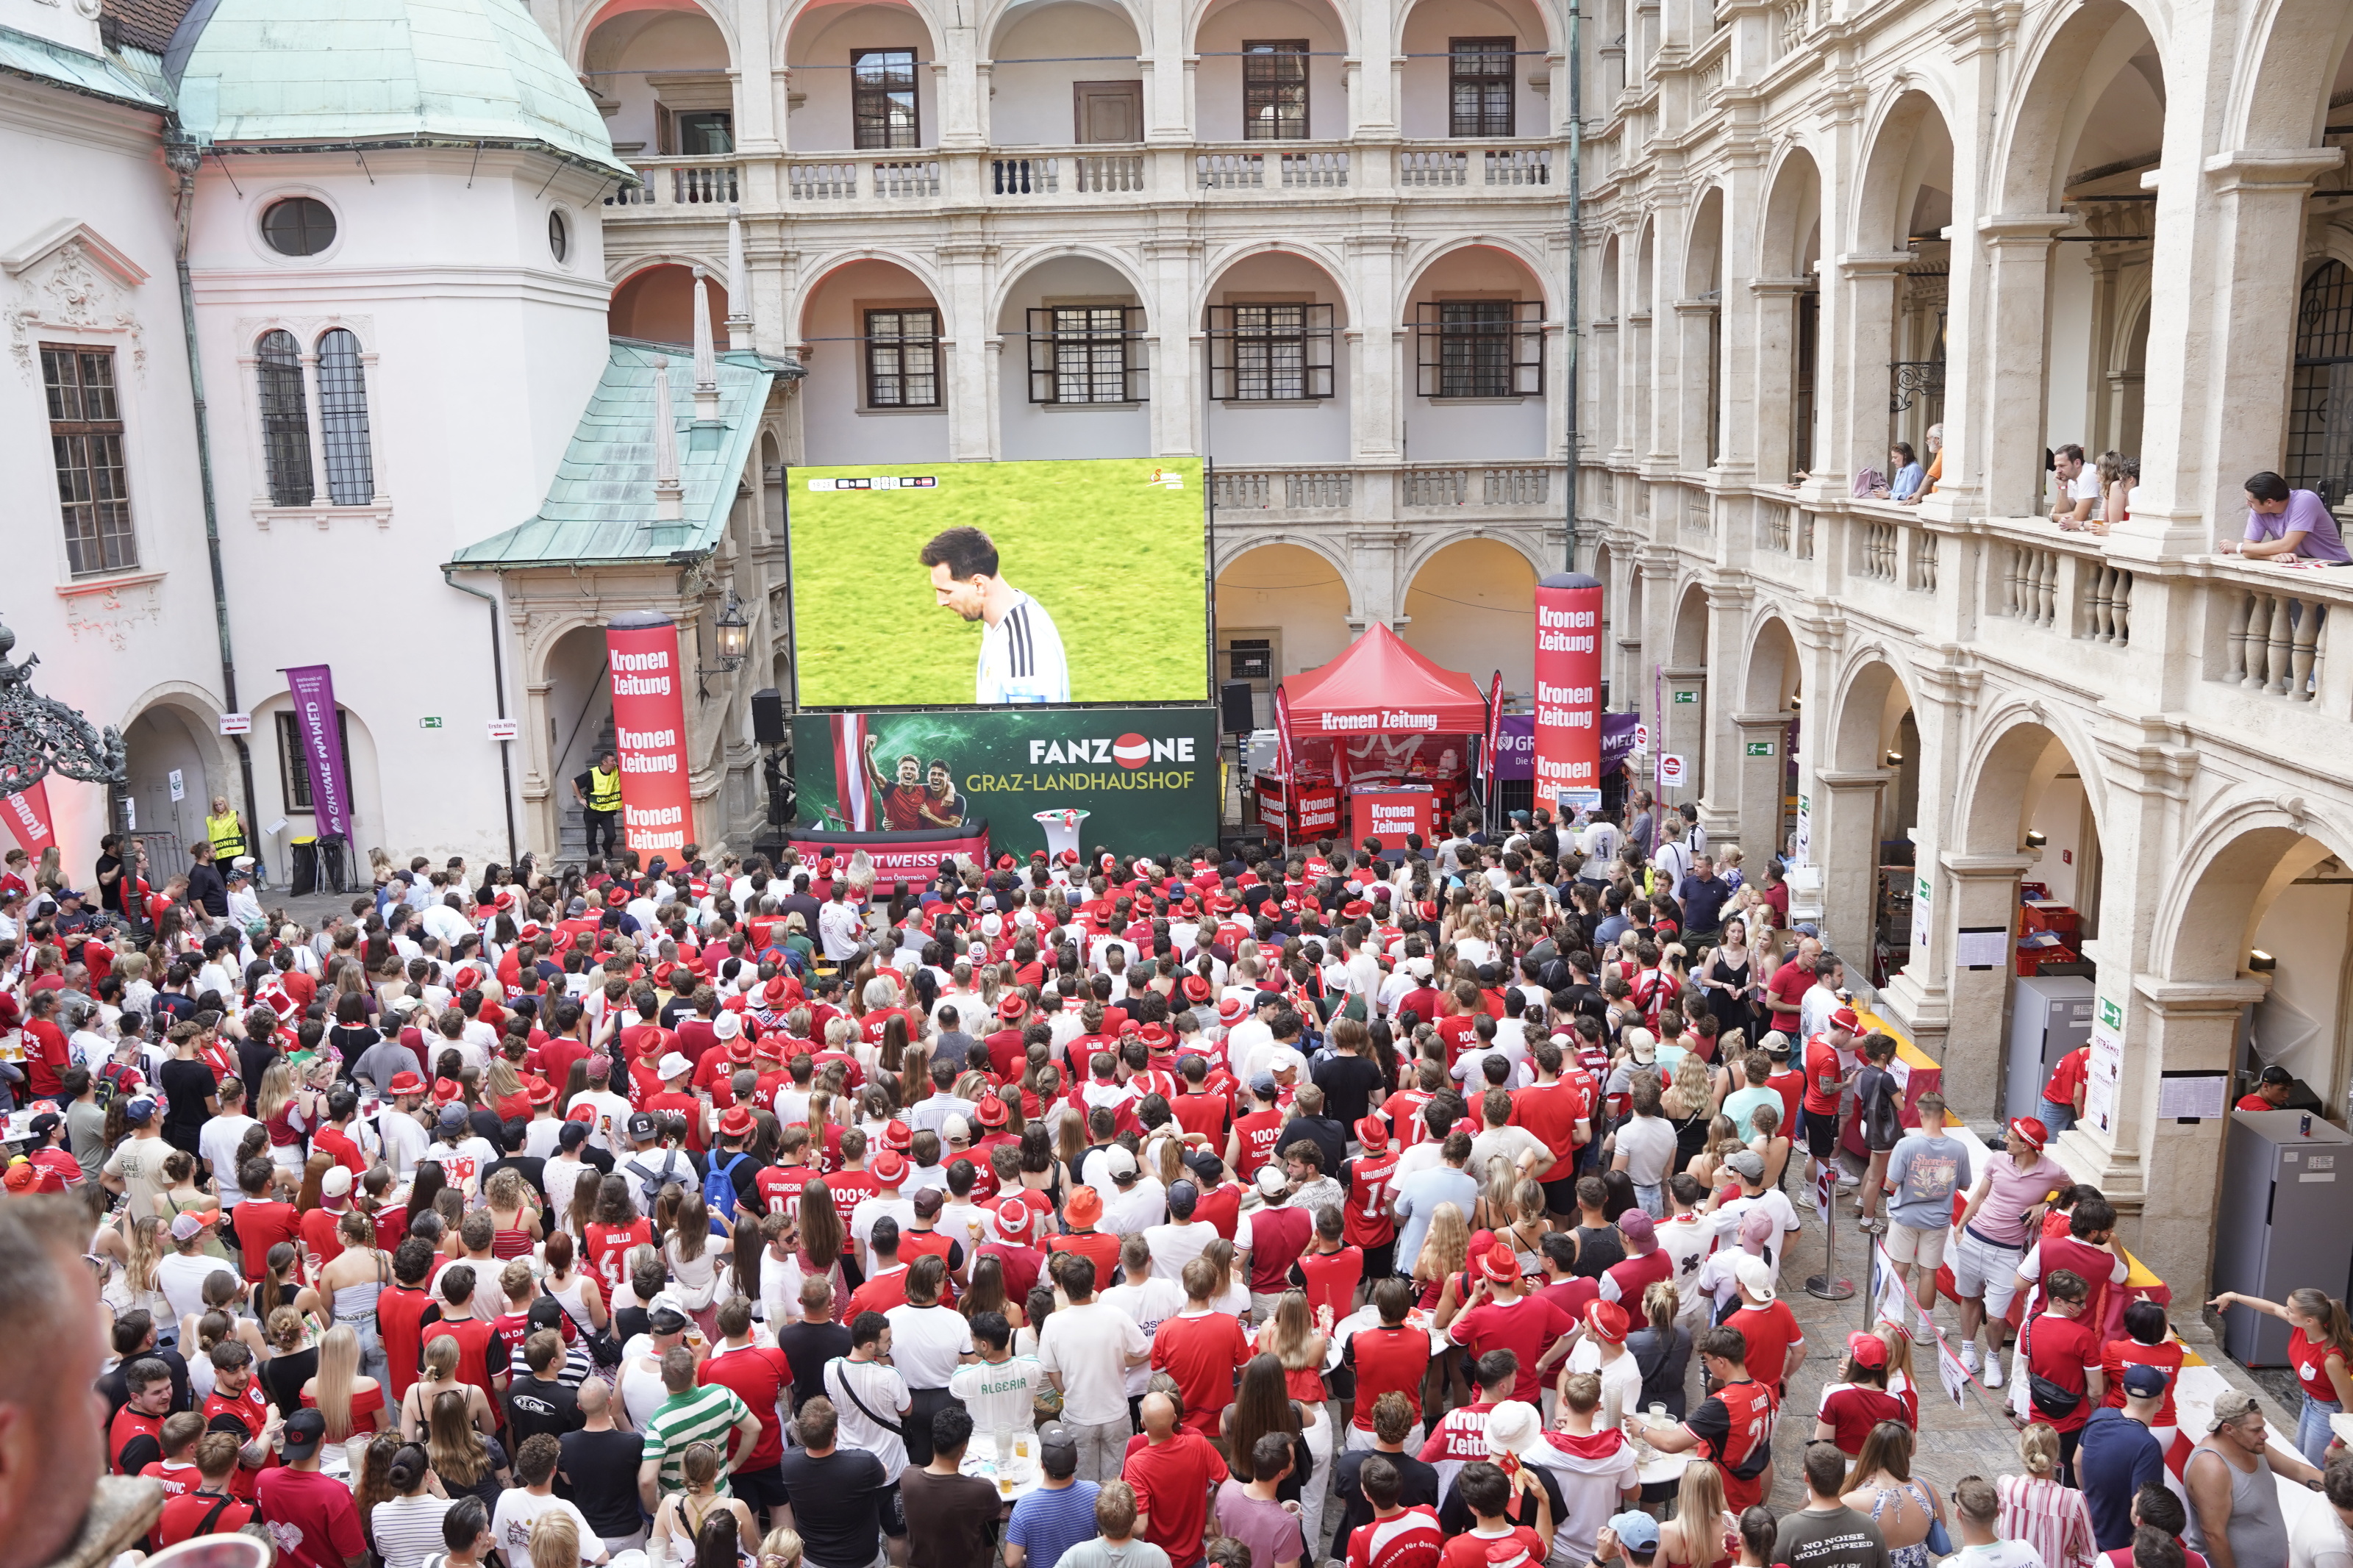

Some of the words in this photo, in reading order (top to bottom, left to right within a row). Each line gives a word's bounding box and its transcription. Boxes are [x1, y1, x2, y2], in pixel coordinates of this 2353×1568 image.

[1539, 606, 1594, 628] Kronen
[1539, 630, 1594, 654] Zeitung
[610, 649, 668, 672] Kronen
[613, 674, 671, 695] Zeitung
[1538, 681, 1593, 704] Kronen
[1322, 712, 1378, 730] Kronen
[1381, 709, 1438, 730] Zeitung
[1538, 705, 1593, 728] Zeitung
[618, 727, 676, 750] Kronen
[620, 751, 677, 774] Zeitung
[1515, 757, 1529, 765] Die
[1537, 755, 1591, 778] Kronen
[965, 771, 1195, 792] GRAZ-LANDHAUSHOF
[1260, 793, 1284, 812] Kronen
[1300, 796, 1335, 813] Kronen
[1372, 803, 1415, 818] Kronen
[624, 803, 682, 826] Kronen
[1260, 809, 1284, 828] Zeitung
[1300, 811, 1335, 828] Zeitung
[1372, 820, 1415, 834] Zeitung
[215, 839, 238, 849] RDNER
[627, 828, 685, 851] Zeitung
[886, 853, 938, 867] WEISS
[507, 984, 525, 996] 100
[1458, 1031, 1477, 1042] 100
[2096, 1035, 2119, 1056] GETRÄNKE
[1575, 1075, 1591, 1086] PRASS
[1889, 1064, 1907, 1080] ETRÄNKE
[1915, 1153, 1957, 1167] Shoreline
[768, 1183, 801, 1192] PROHASKA
[831, 1188, 873, 1203] 100%
[606, 1232, 632, 1244] WOLLO
[981, 1377, 1027, 1395] ALGERIA
[1445, 1408, 1491, 1431] Kron
[1446, 1432, 1492, 1456] Zeitu
[1405, 1542, 1417, 1551] für
[1794, 1547, 1831, 1561] HOLD
[1832, 1541, 1874, 1550] SPEED
[1802, 1541, 1822, 1550] NO
[1824, 1533, 1865, 1546] NOISE
